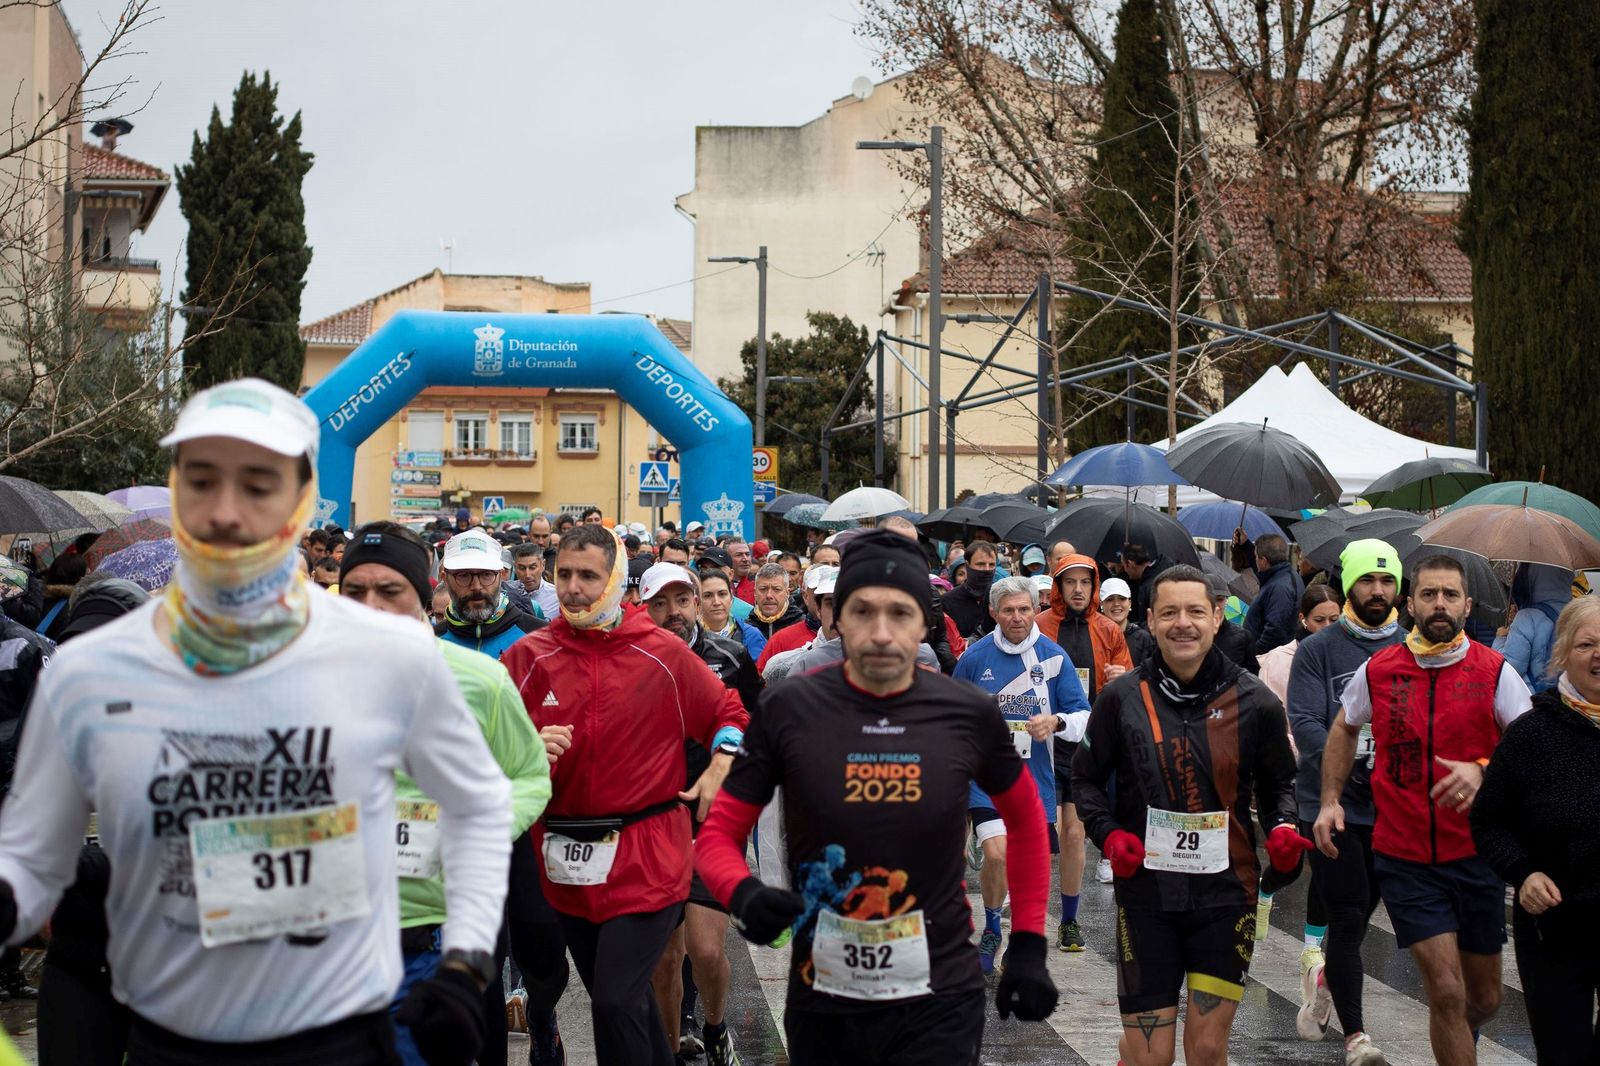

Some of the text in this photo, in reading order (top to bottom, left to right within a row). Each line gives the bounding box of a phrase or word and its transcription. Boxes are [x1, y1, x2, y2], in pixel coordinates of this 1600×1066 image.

[509, 339, 578, 353] Diputación
[508, 357, 577, 368] de Granada
[328, 351, 412, 432] DEPORTES
[635, 354, 719, 431] DEPORTES
[752, 457, 767, 466] 30
[1000, 694, 1048, 706] DEPORTIVO
[263, 727, 332, 765] XII
[847, 753, 921, 763] GRAN PREMIO
[846, 763, 922, 780] FONDO
[147, 768, 334, 806] CARRERA
[844, 779, 922, 802] 2025
[1176, 831, 1200, 851] 29
[563, 843, 593, 862] 160
[252, 849, 312, 891] 317
[843, 943, 894, 971] 352
